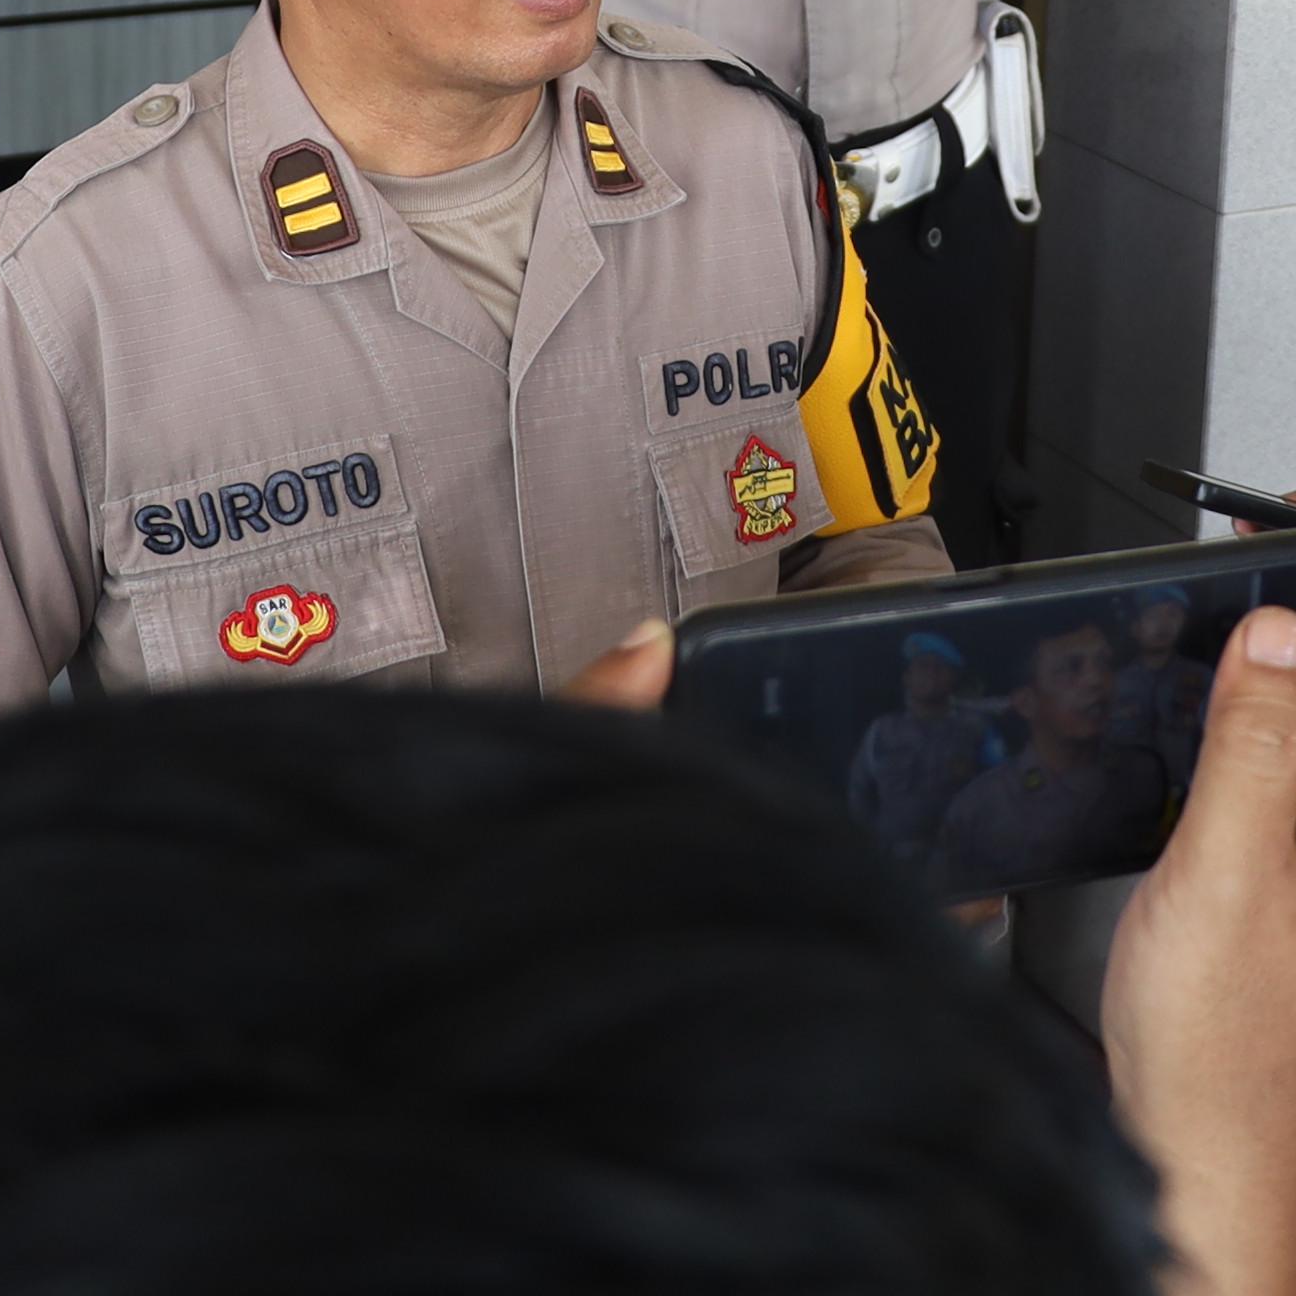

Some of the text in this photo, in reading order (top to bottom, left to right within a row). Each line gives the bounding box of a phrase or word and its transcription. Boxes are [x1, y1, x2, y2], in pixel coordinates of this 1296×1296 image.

[662, 336, 804, 417] POLRI
[134, 452, 381, 556] SUROTO
[258, 597, 288, 615] SAR
